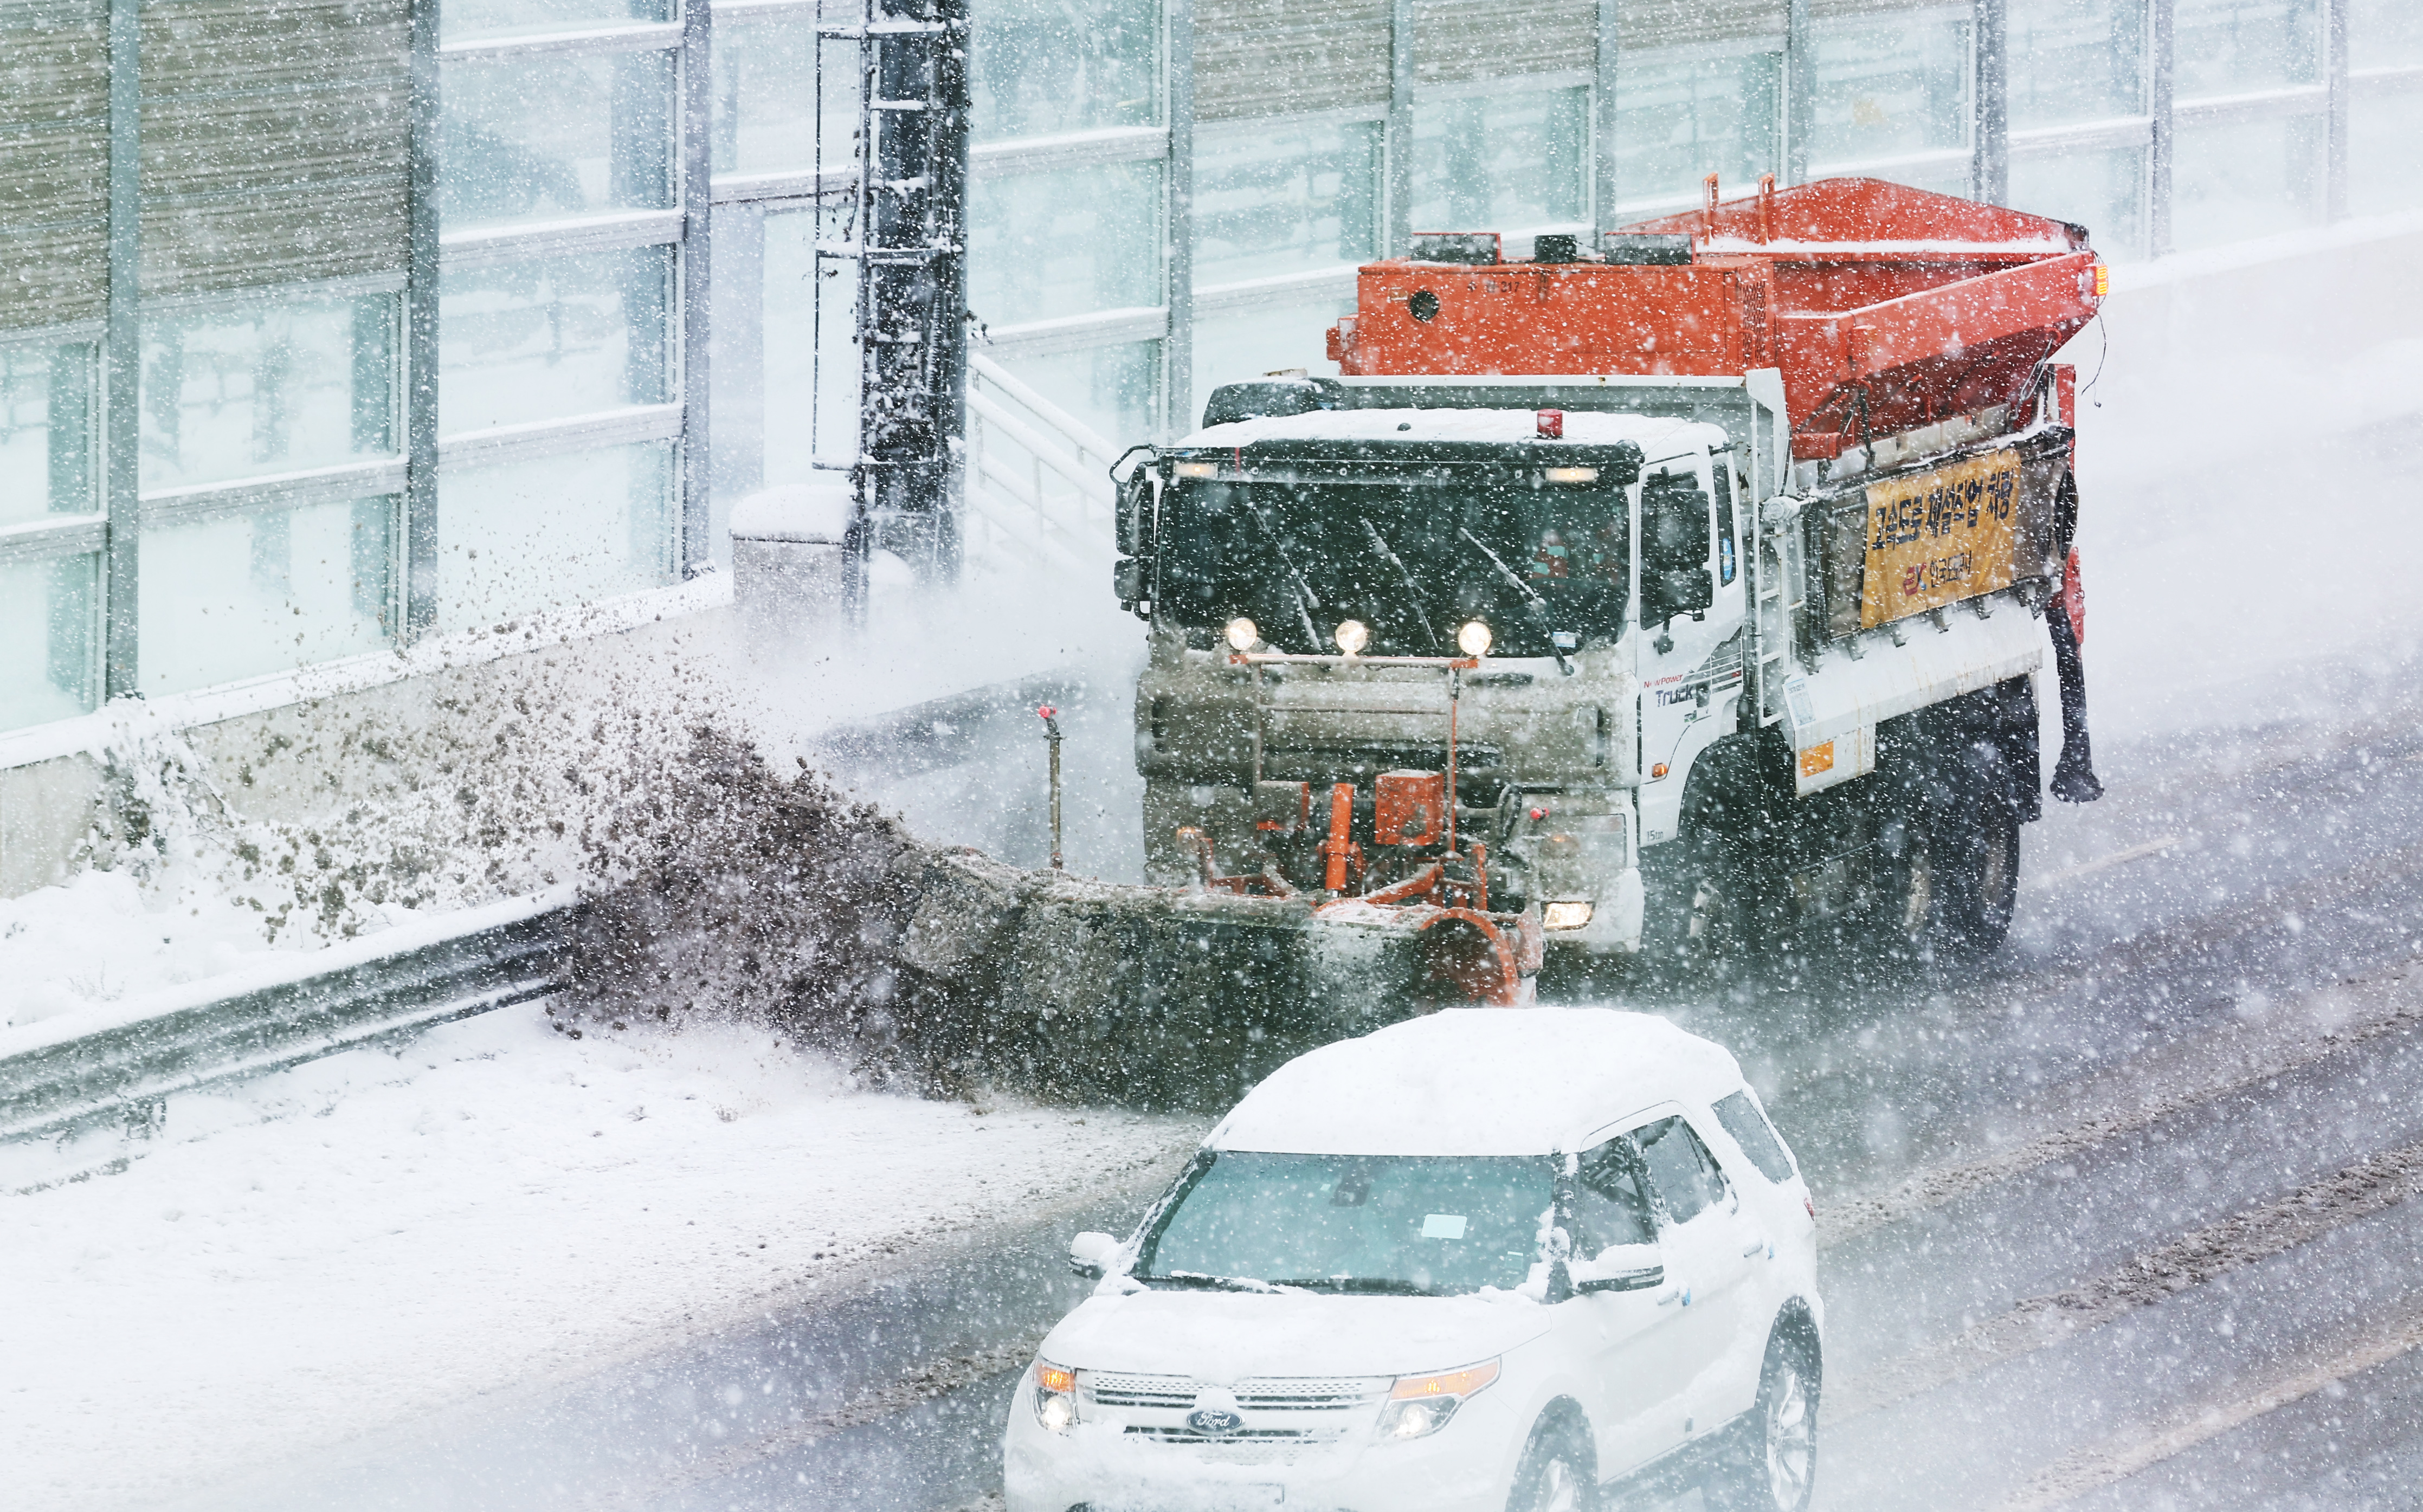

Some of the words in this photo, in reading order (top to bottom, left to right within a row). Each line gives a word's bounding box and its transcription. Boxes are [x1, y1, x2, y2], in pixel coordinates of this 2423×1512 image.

[1872, 495, 1923, 550] 고속도로
[1986, 468, 2014, 521] 차량
[1655, 684, 1693, 707] Truck
[1197, 1412, 1230, 1426] Ford
